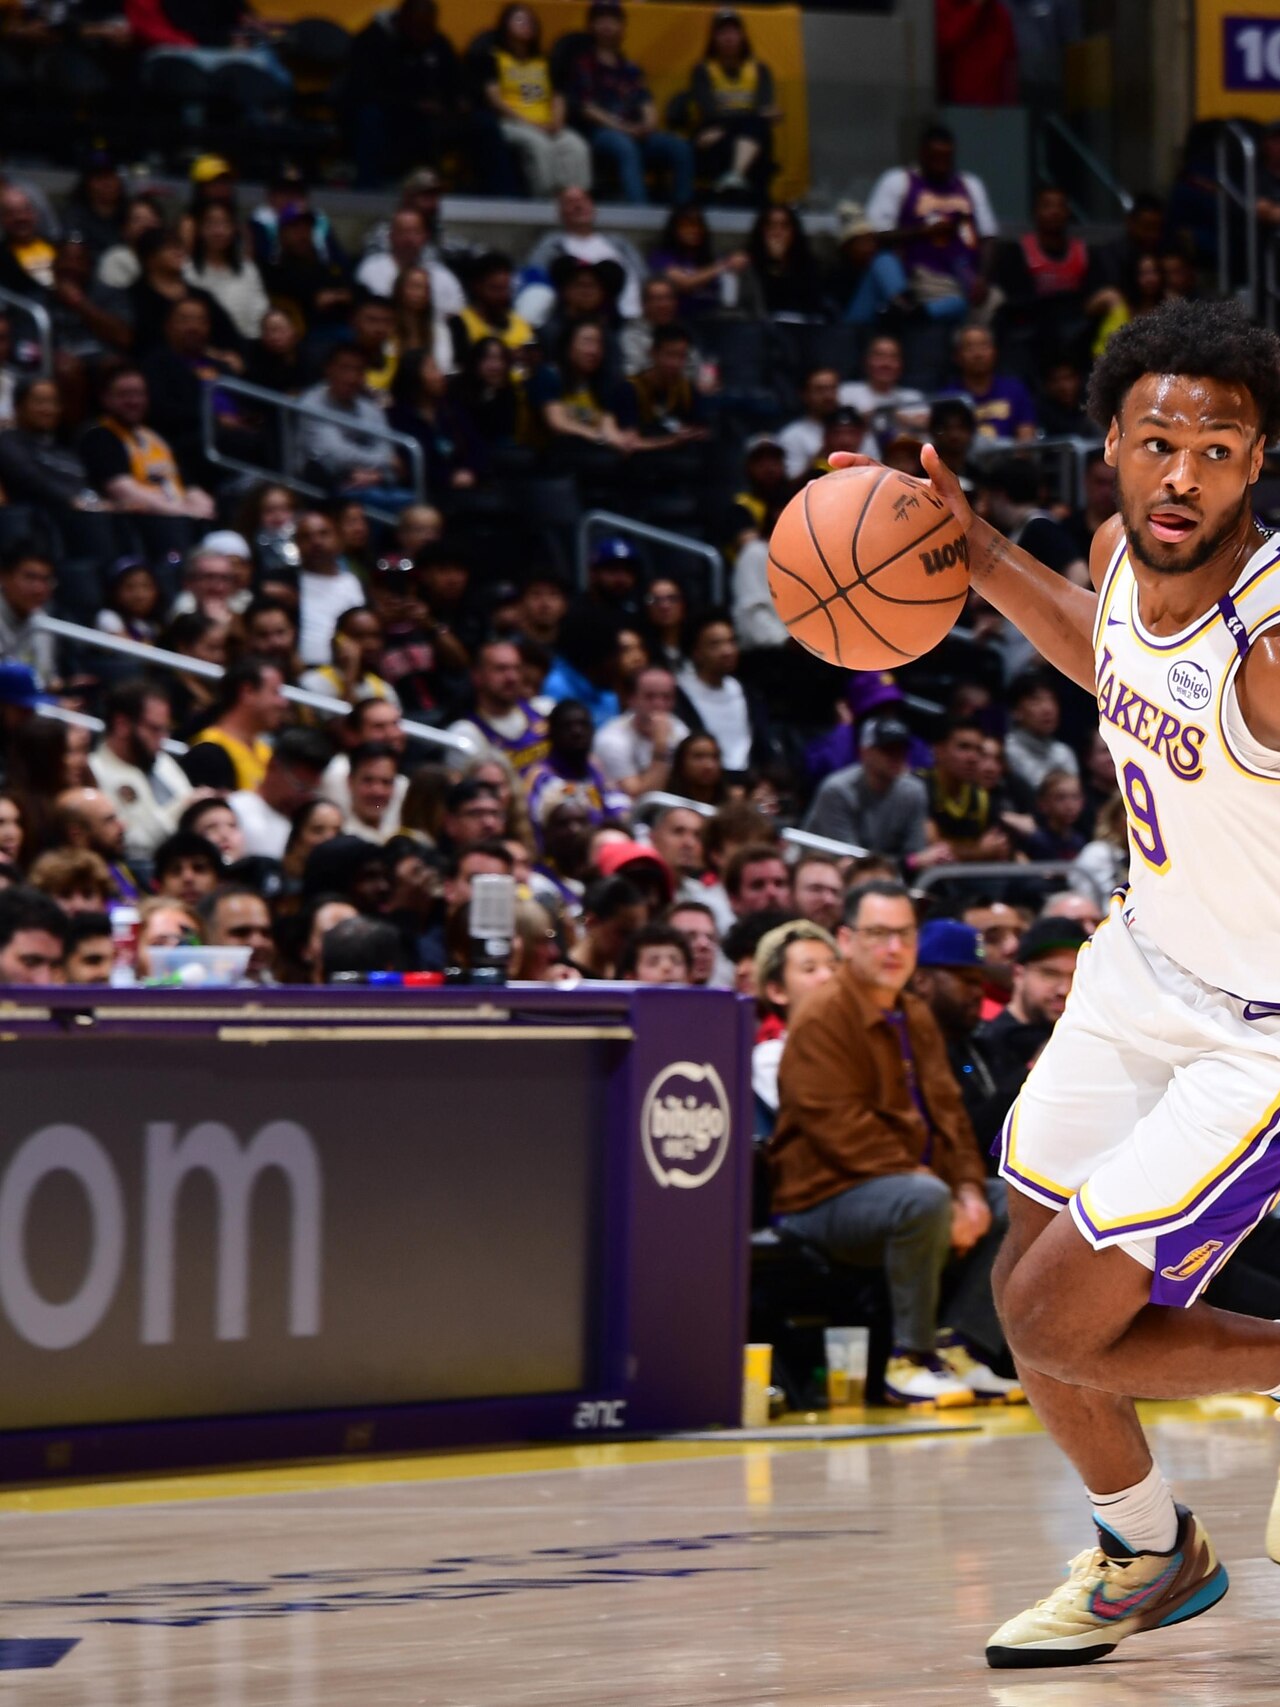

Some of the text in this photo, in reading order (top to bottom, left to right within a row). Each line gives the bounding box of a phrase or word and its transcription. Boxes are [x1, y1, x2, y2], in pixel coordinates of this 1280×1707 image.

[1227, 616, 1244, 636] 44
[1172, 668, 1209, 699] bibigo
[1121, 758, 1170, 873] 9
[651, 1094, 723, 1152] bibigo
